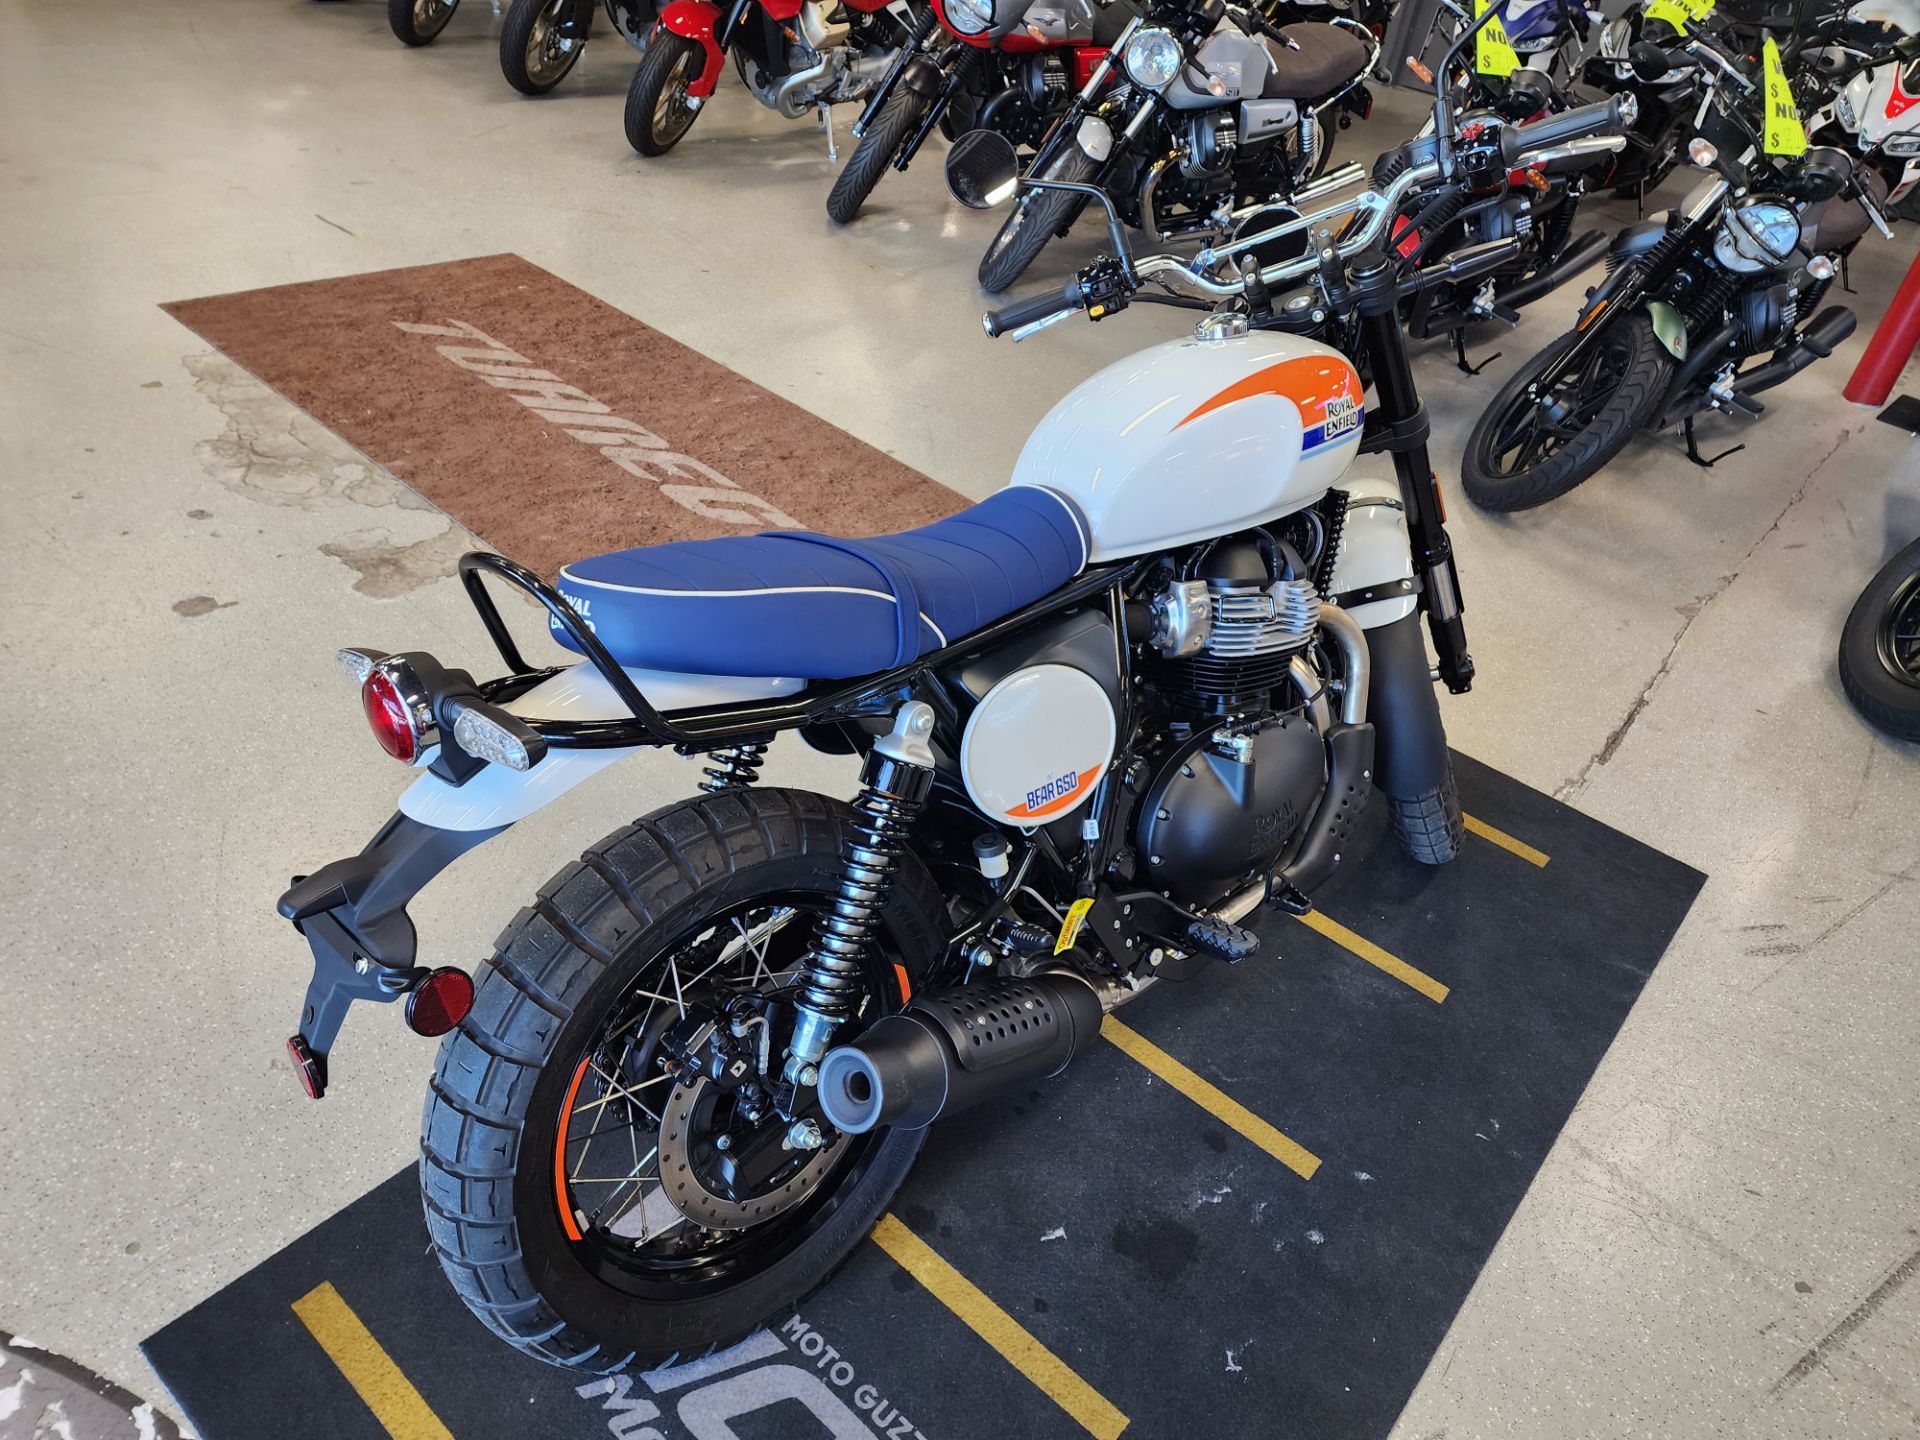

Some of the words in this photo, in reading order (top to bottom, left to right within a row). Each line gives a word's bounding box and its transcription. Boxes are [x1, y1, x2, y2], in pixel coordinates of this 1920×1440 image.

[1326, 396, 1355, 418] ROYAL
[1326, 411, 1357, 438] ENFIELD
[1055, 770, 1078, 796] 650
[780, 1313, 855, 1387] MOTO
[853, 1383, 929, 1440] GUZ
